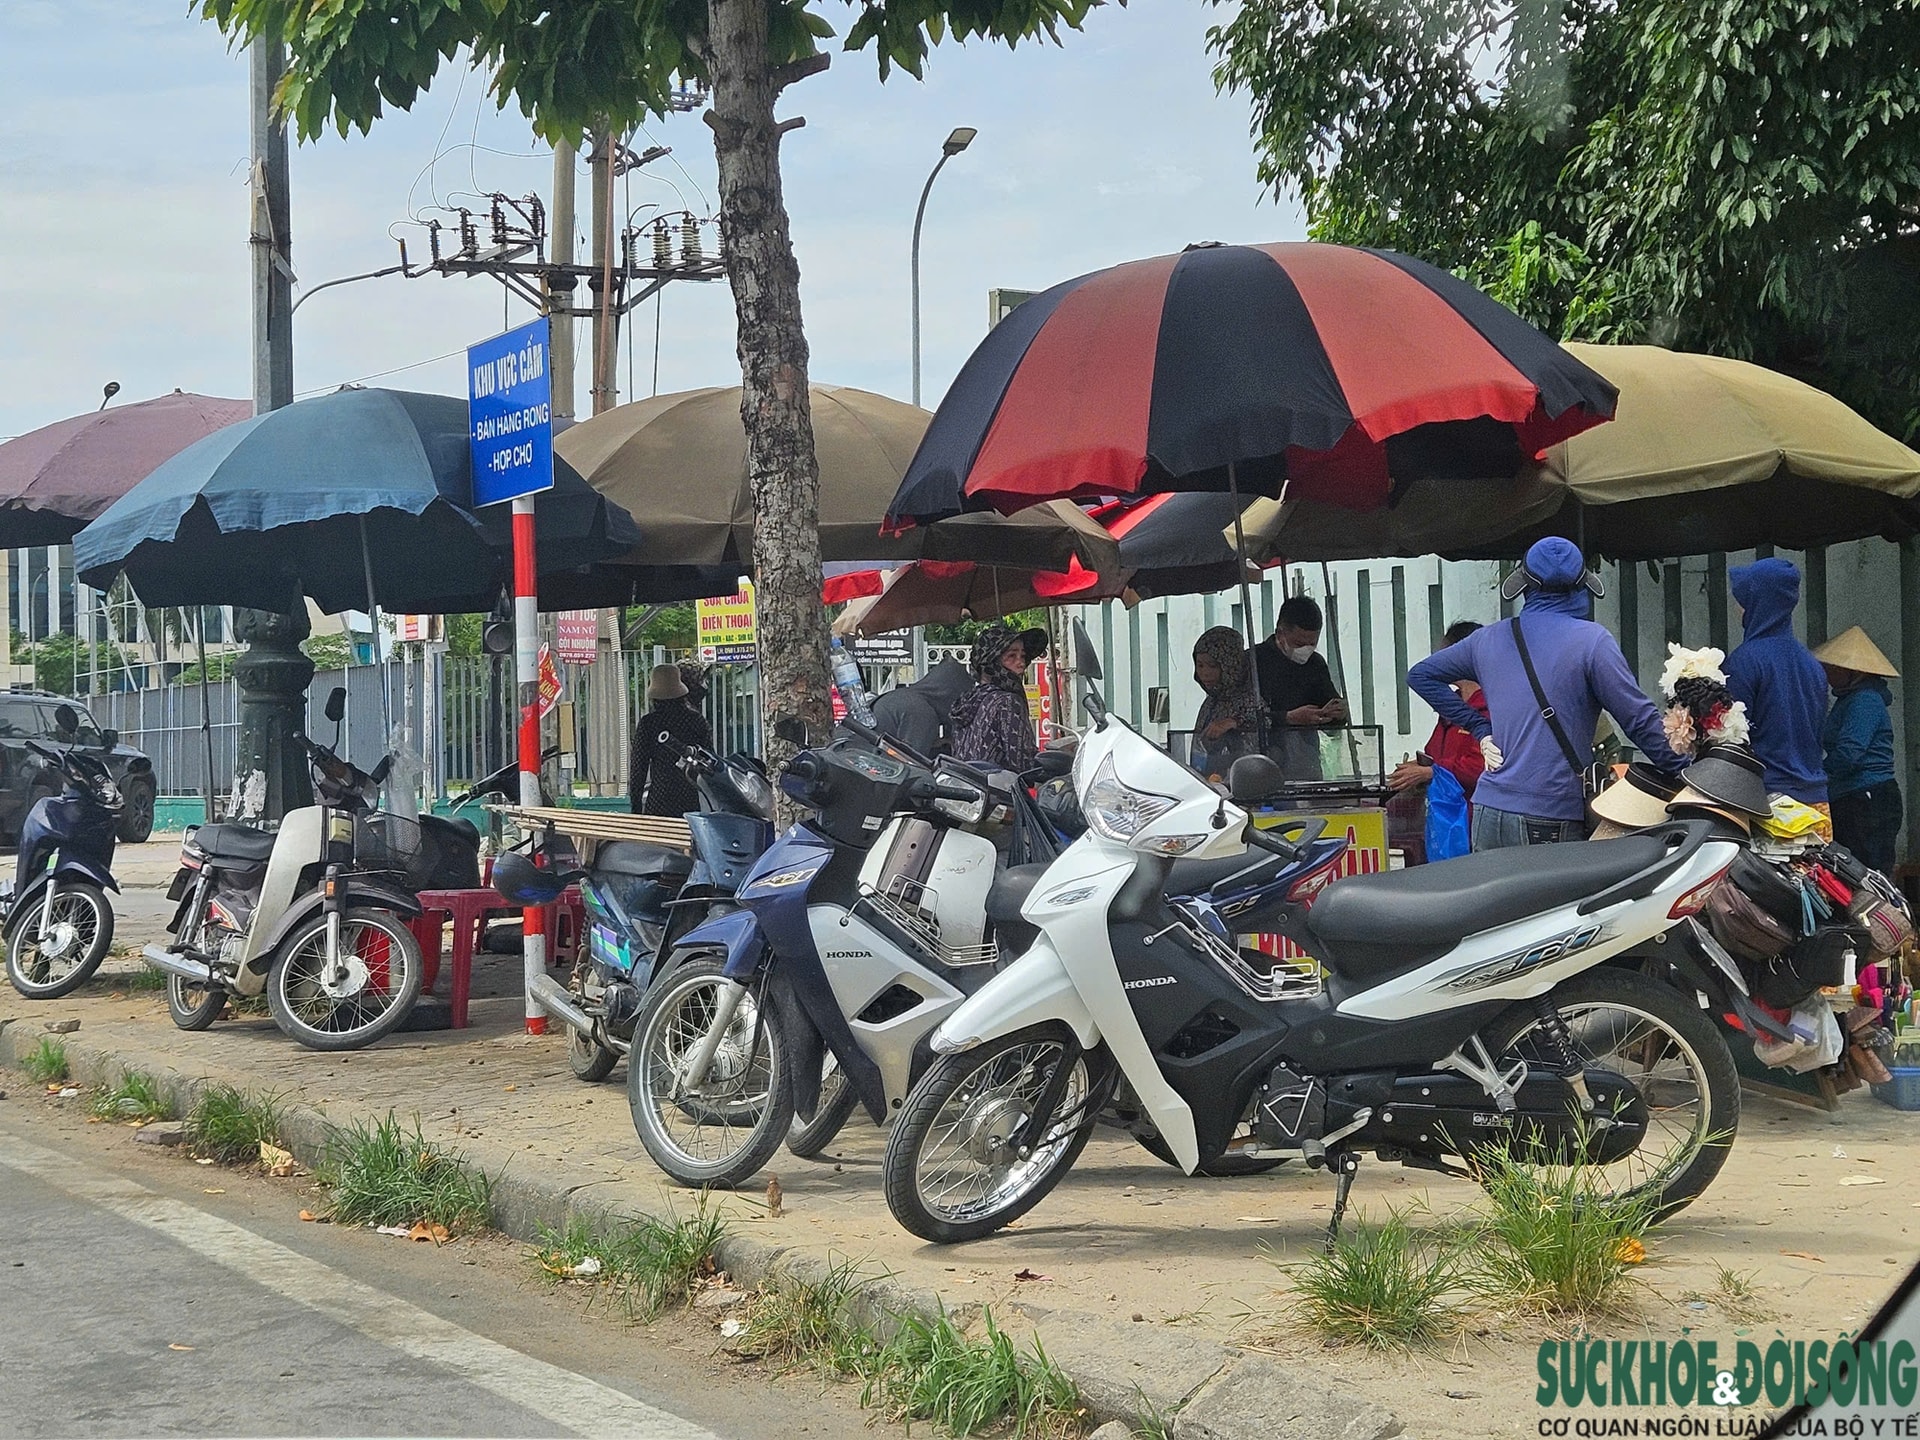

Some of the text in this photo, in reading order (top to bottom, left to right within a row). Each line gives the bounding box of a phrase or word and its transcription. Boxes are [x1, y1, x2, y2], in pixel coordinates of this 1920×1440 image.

[474, 334, 543, 399] KHU VỰC CẤM
[496, 411, 522, 437] HÀNG
[523, 403, 549, 429] RONG
[513, 440, 533, 468] CHỢ
[725, 613, 752, 630] THOẠI
[1125, 976, 1178, 990] HONDA
